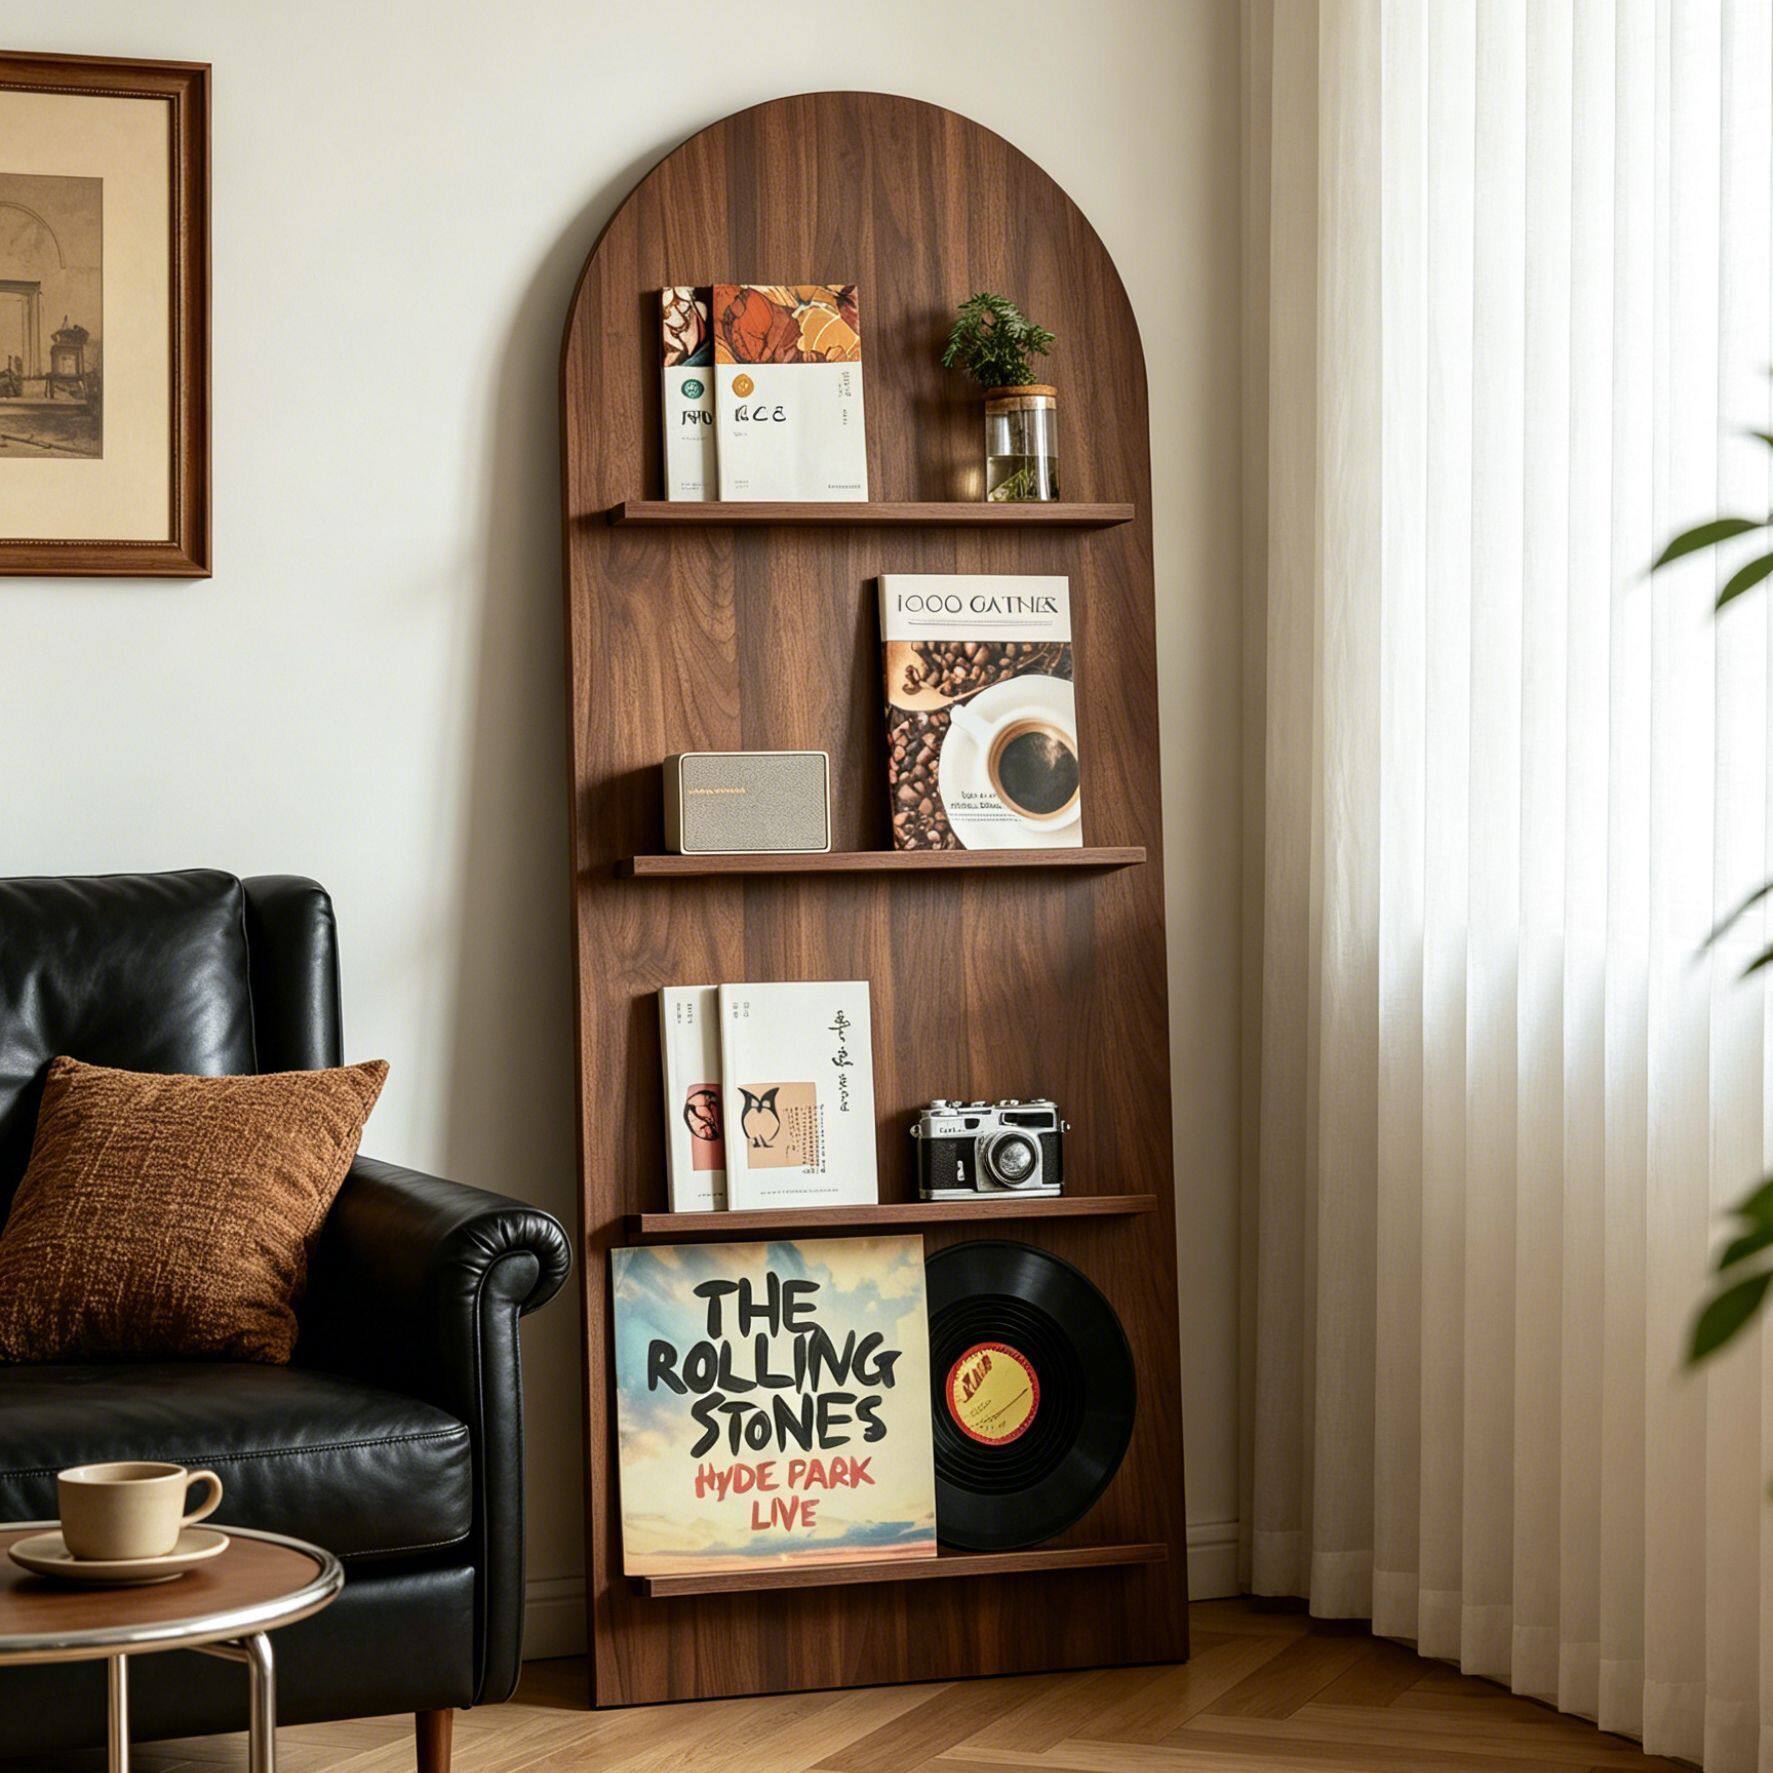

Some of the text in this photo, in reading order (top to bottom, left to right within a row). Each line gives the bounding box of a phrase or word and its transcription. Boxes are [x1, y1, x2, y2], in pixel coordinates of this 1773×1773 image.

[693, 1271, 820, 1340] THE
[648, 1326, 903, 1395] ROLLING
[690, 1391, 888, 1459] STONES
[694, 1455, 876, 1502] HYDE PARK
[751, 1495, 820, 1532] LIVE
